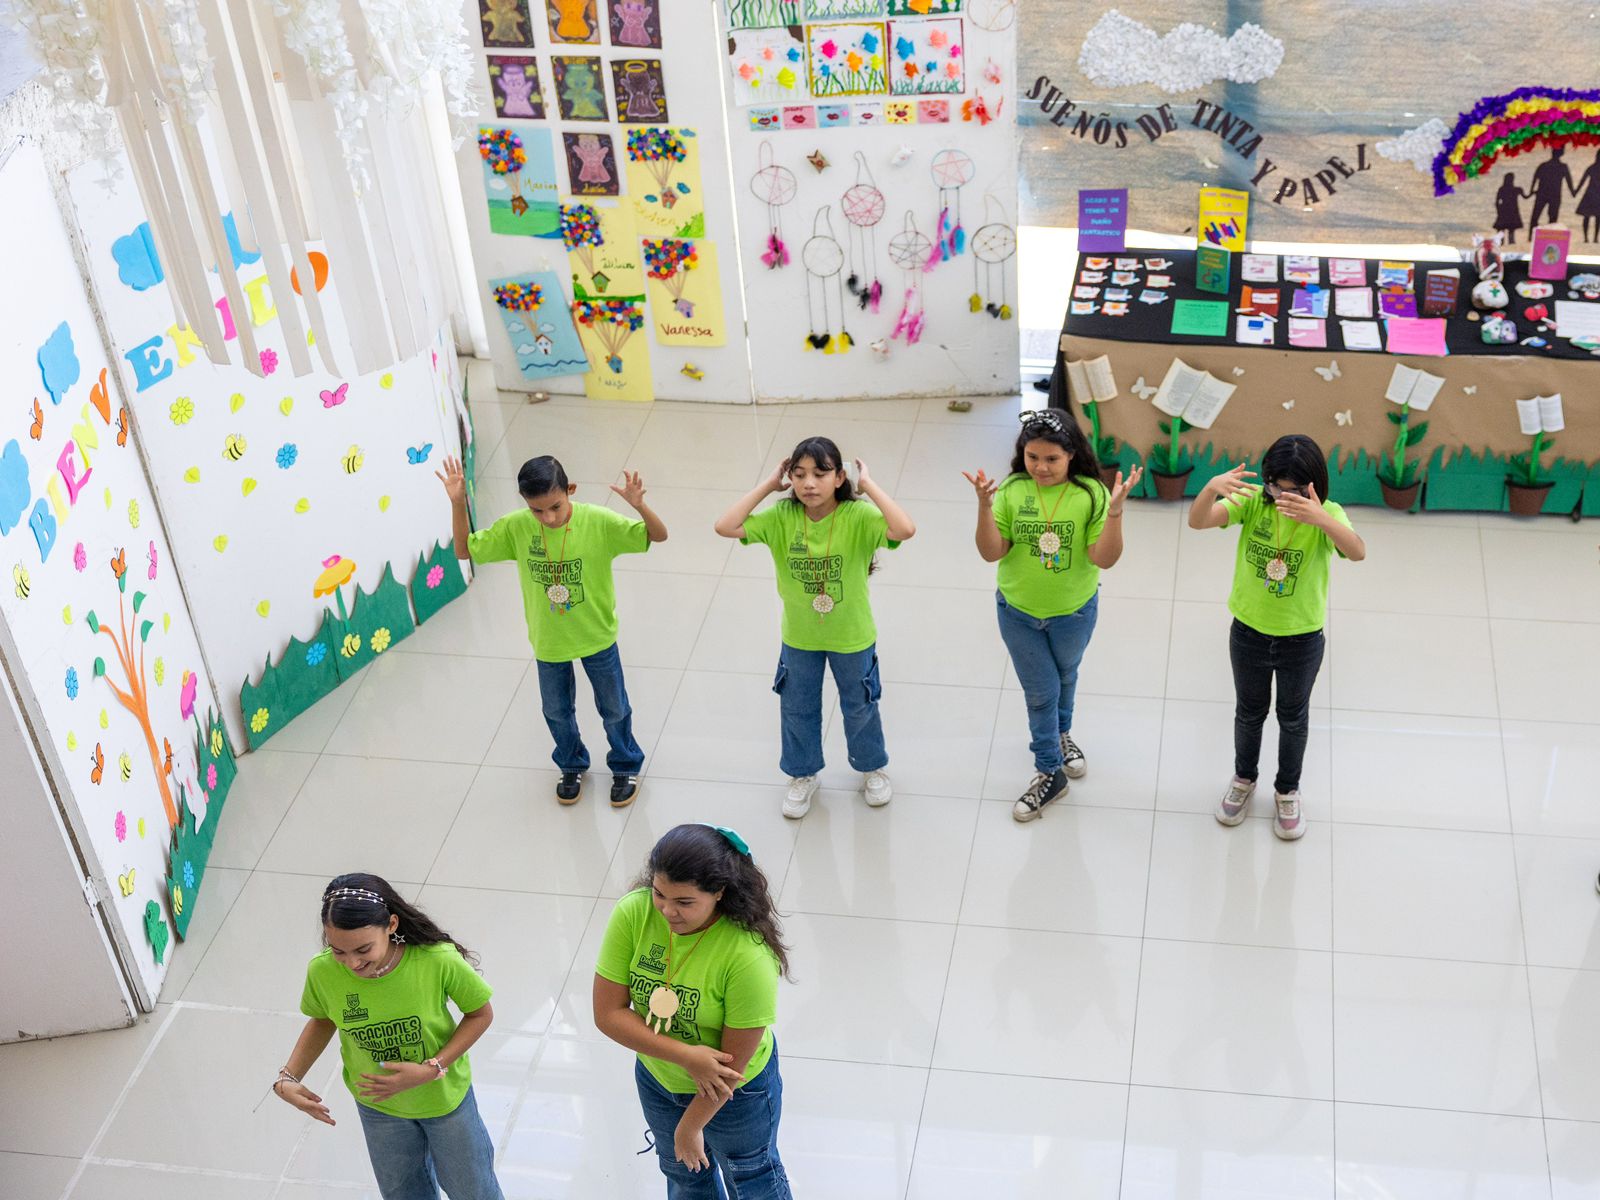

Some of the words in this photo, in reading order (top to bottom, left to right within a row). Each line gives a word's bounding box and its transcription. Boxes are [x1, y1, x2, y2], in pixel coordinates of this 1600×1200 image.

[1136, 104, 1178, 142] DE
[1191, 99, 1263, 159] TINTA
[1250, 158, 1277, 187] Y
[1273, 143, 1371, 205] PAPEL
[660, 323, 714, 338] Vanessa
[804, 583, 824, 593] 2025
[641, 955, 666, 970] Delicias
[343, 1008, 368, 1018] Delicias
[373, 1048, 398, 1061] 2025
